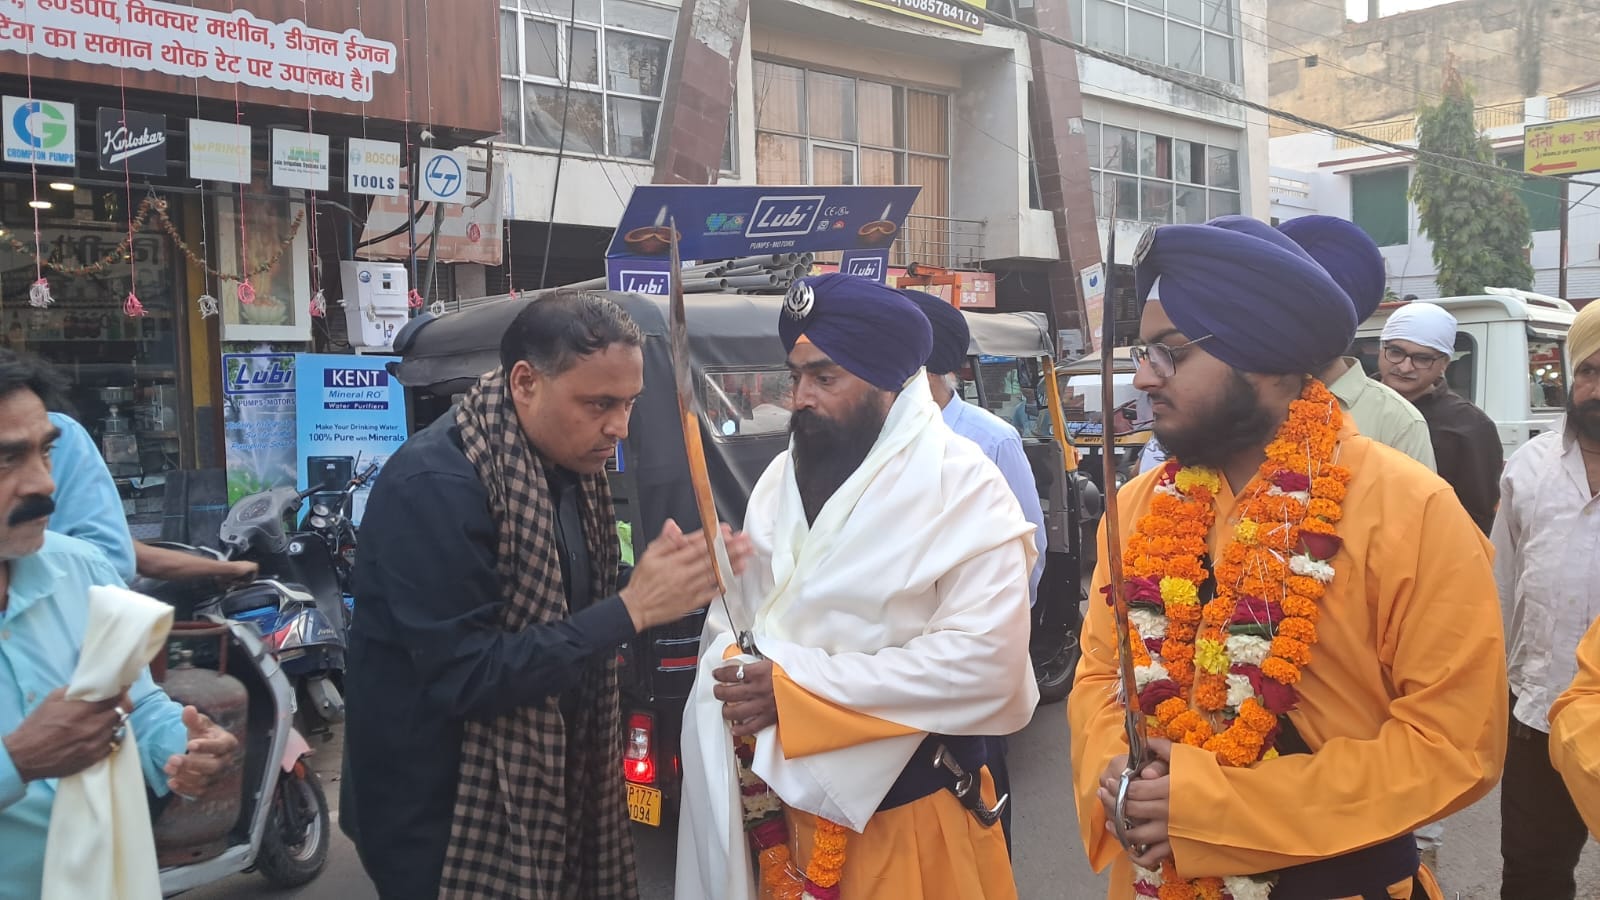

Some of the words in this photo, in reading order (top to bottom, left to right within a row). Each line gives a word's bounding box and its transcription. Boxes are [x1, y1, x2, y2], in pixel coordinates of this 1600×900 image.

[125, 0, 199, 33] मिक्चर
[206, 17, 275, 50] मशीन,
[284, 27, 338, 56] डीजल
[344, 34, 390, 64] ईजन
[42, 26, 77, 50] का
[83, 32, 153, 61] समान
[160, 40, 209, 68] थोक
[214, 46, 242, 74] रेट
[246, 57, 273, 78] पर
[278, 63, 345, 89] उपलब्ध
[102, 126, 166, 155] Kirloskar
[49, 152, 74, 163] PUMPS
[365, 152, 399, 165] BOSCH
[353, 174, 395, 190] TOOLS
[757, 205, 812, 228] Lubi
[852, 262, 878, 276] Lubi
[627, 277, 665, 294] Lubi
[235, 362, 295, 385] Lubi
[332, 369, 380, 387] KENT
[329, 390, 363, 399] Mineral
[350, 423, 378, 431] Drinking
[309, 433, 333, 441] 100%
[334, 433, 355, 441] Pure
[368, 434, 405, 442] Minerals
